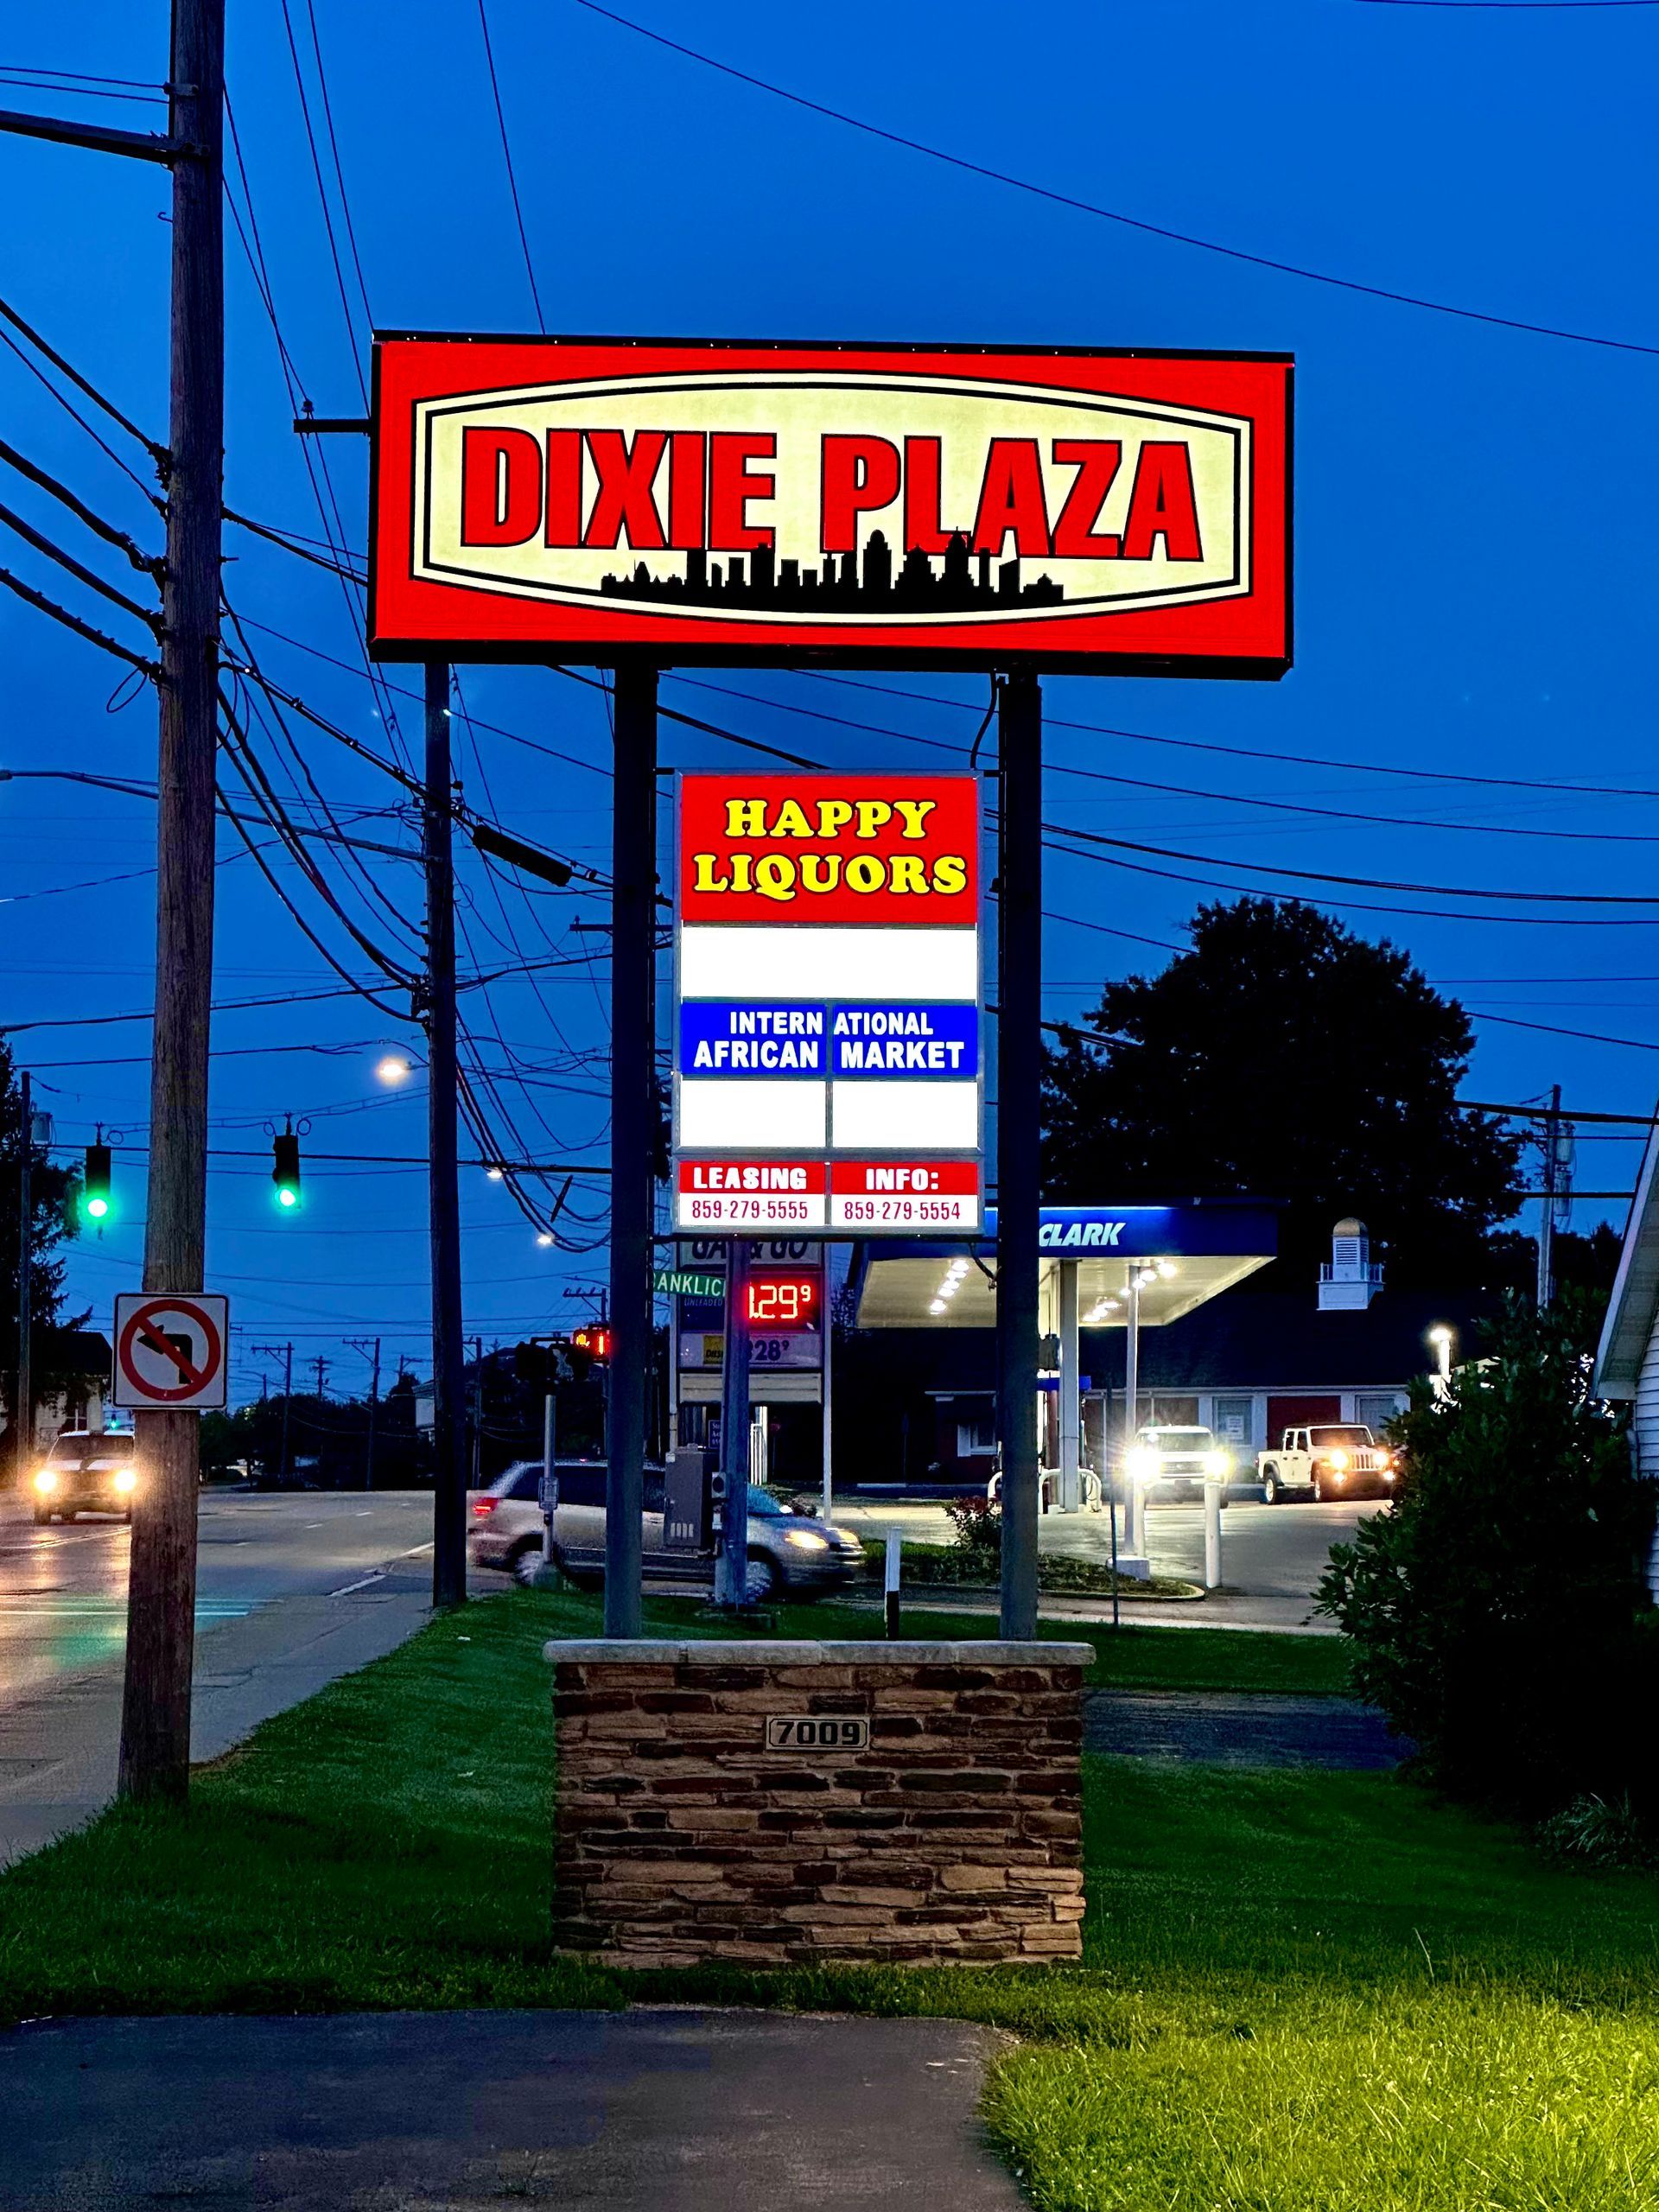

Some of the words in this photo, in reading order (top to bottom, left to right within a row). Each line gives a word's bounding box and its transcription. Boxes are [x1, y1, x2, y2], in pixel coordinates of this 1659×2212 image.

[461, 426, 777, 551] DIXIE
[820, 433, 1205, 562] PLAZA
[725, 799, 937, 839] HAPPY
[693, 854, 967, 901] LIQUORS
[693, 1040, 818, 1069] AFRICAN
[841, 1040, 965, 1070] MARKET
[693, 1166, 807, 1190] LEASING
[865, 1167, 939, 1191] INFO:
[692, 1199, 809, 1219] 859-279-5555
[843, 1200, 961, 1220] 859-279-5554
[1039, 1222, 1127, 1247] CLARK
[653, 1271, 727, 1298] ANKLIC
[776, 1720, 861, 1745] 7009
